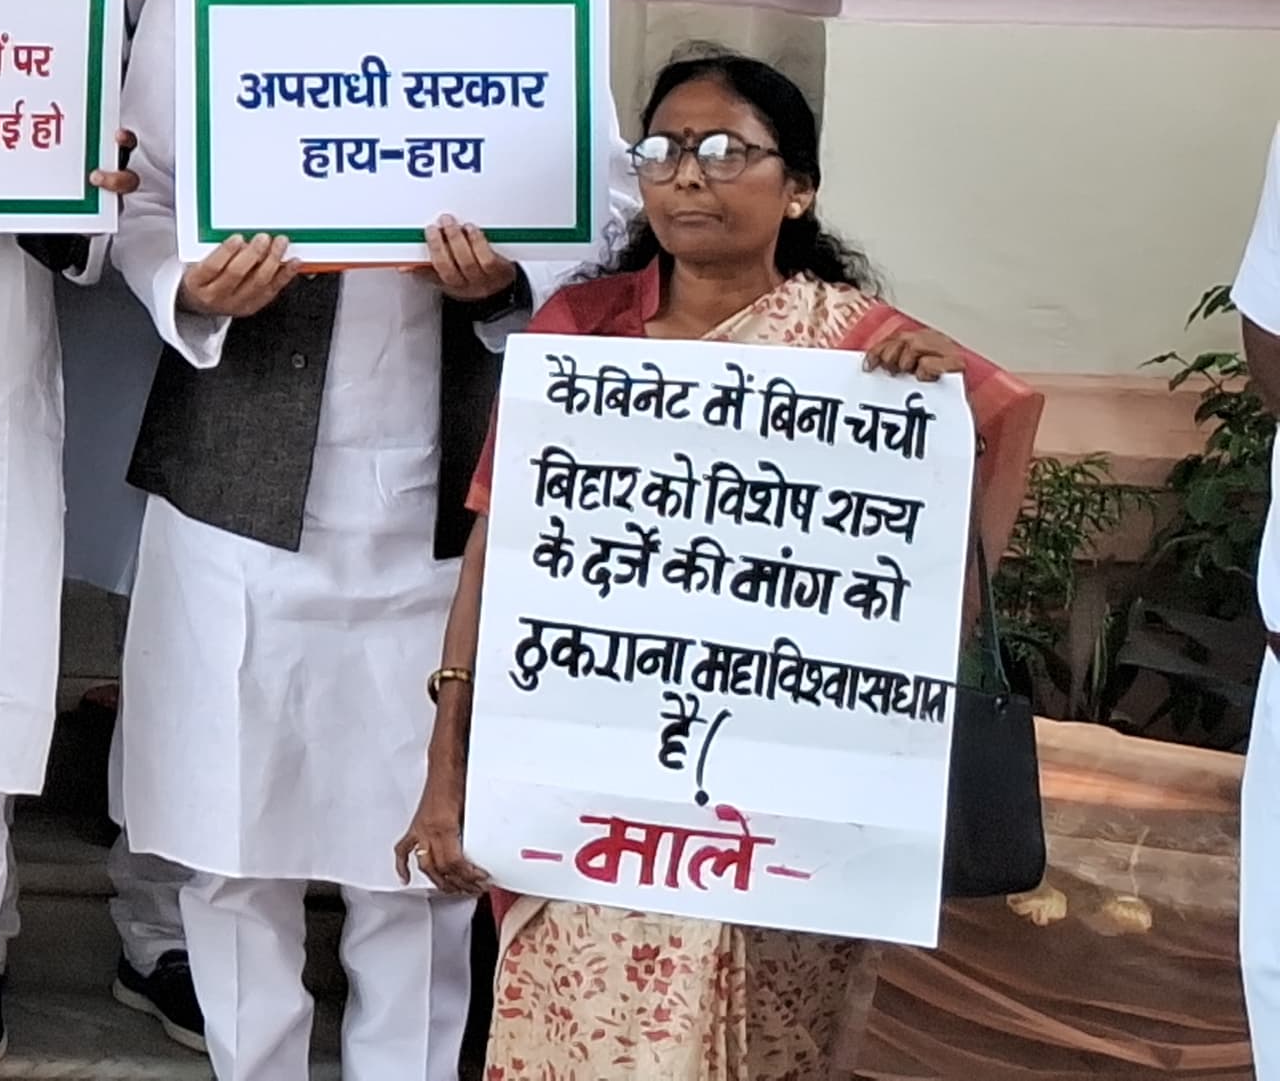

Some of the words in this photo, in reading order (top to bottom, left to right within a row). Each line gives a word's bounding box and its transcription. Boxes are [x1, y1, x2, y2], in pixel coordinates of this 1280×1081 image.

[13, 46, 53, 77] पर
[237, 56, 391, 109] अपराधी
[402, 72, 548, 108] सरकार
[31, 102, 64, 149] हो
[300, 138, 485, 178] हाय-हाय
[546, 355, 699, 419] कैबिनेट
[703, 363, 754, 430] में
[759, 377, 843, 445] बिना
[531, 446, 641, 512] बिहार
[642, 453, 701, 519] को
[703, 461, 821, 533] विशेष
[822, 490, 925, 544] राज्य
[533, 516, 574, 578] के
[663, 536, 734, 595] की
[730, 547, 842, 614] मांग
[844, 556, 911, 621] को
[509, 618, 696, 691] ठुकराना
